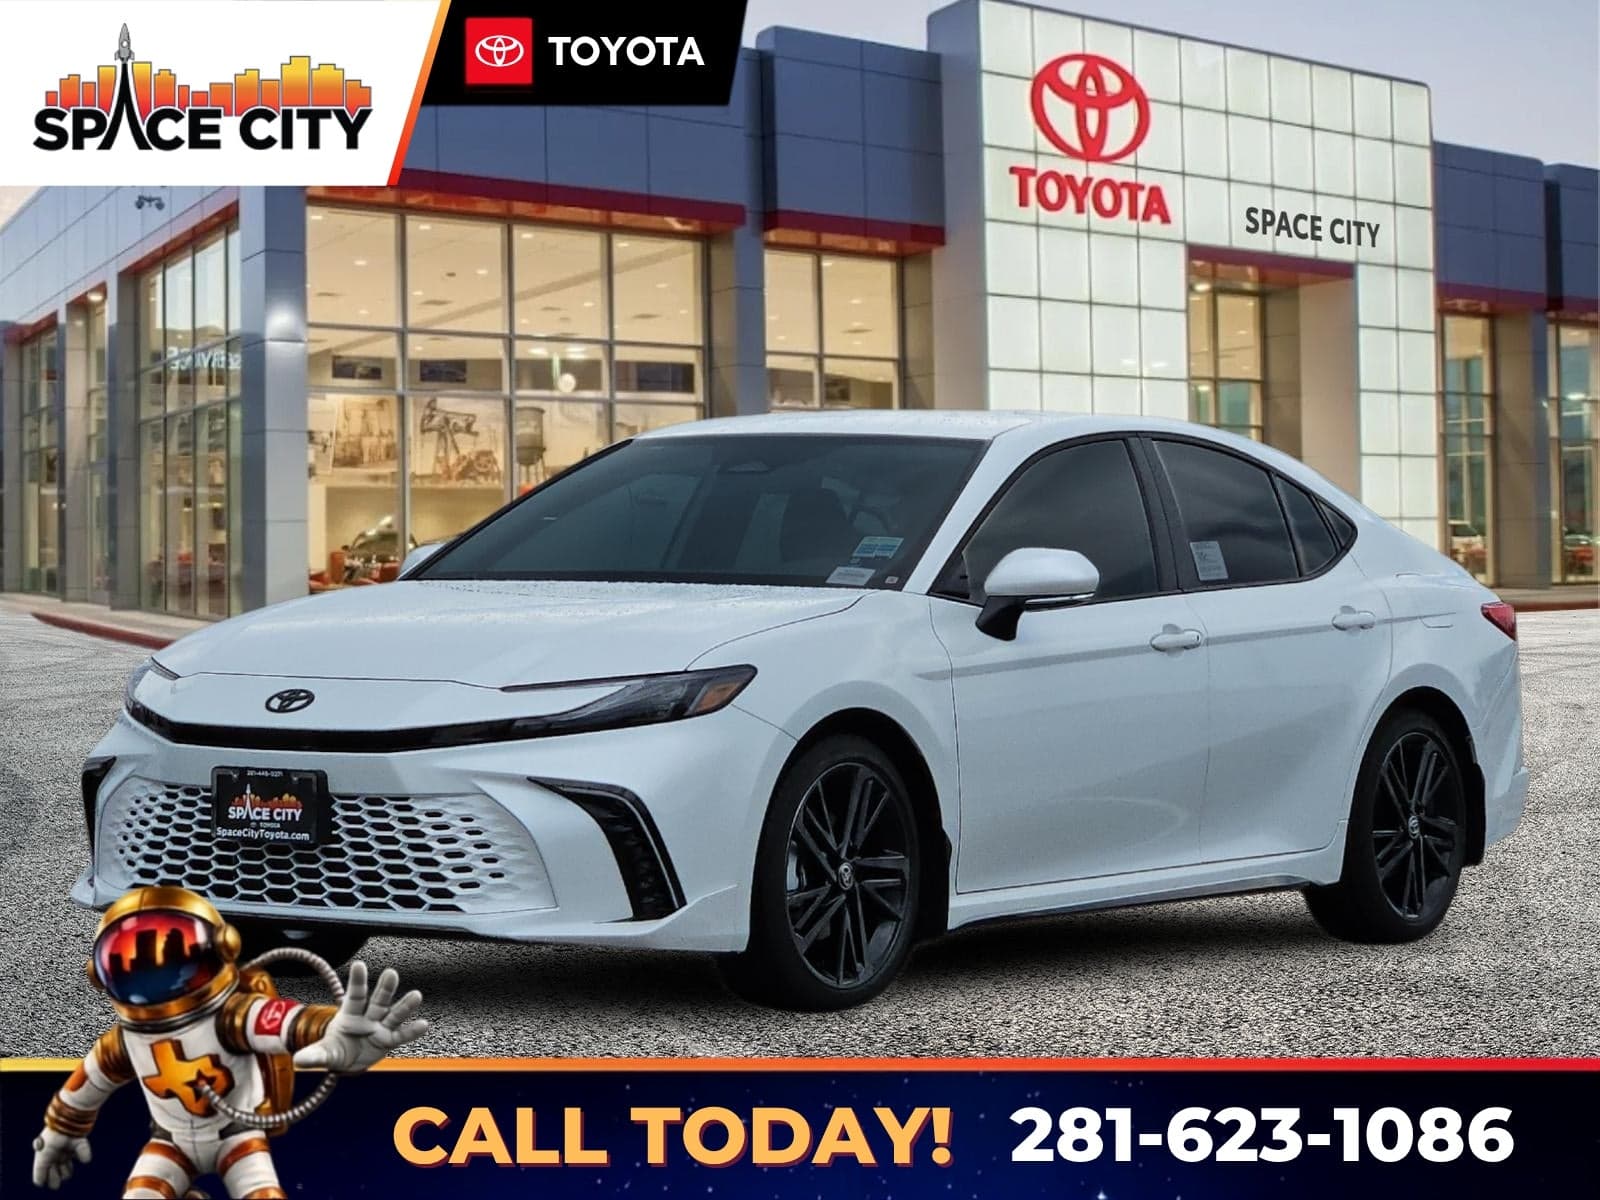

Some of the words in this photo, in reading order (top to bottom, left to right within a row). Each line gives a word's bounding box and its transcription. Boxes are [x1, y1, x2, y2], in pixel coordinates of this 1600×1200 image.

[1009, 166, 1171, 224] TOYOTA
[1245, 206, 1323, 241] SPACE
[1329, 216, 1381, 248] CITY
[228, 805, 271, 820] SPACE
[273, 807, 303, 821] CITY
[215, 826, 310, 841] SpaceCityToyota.com
